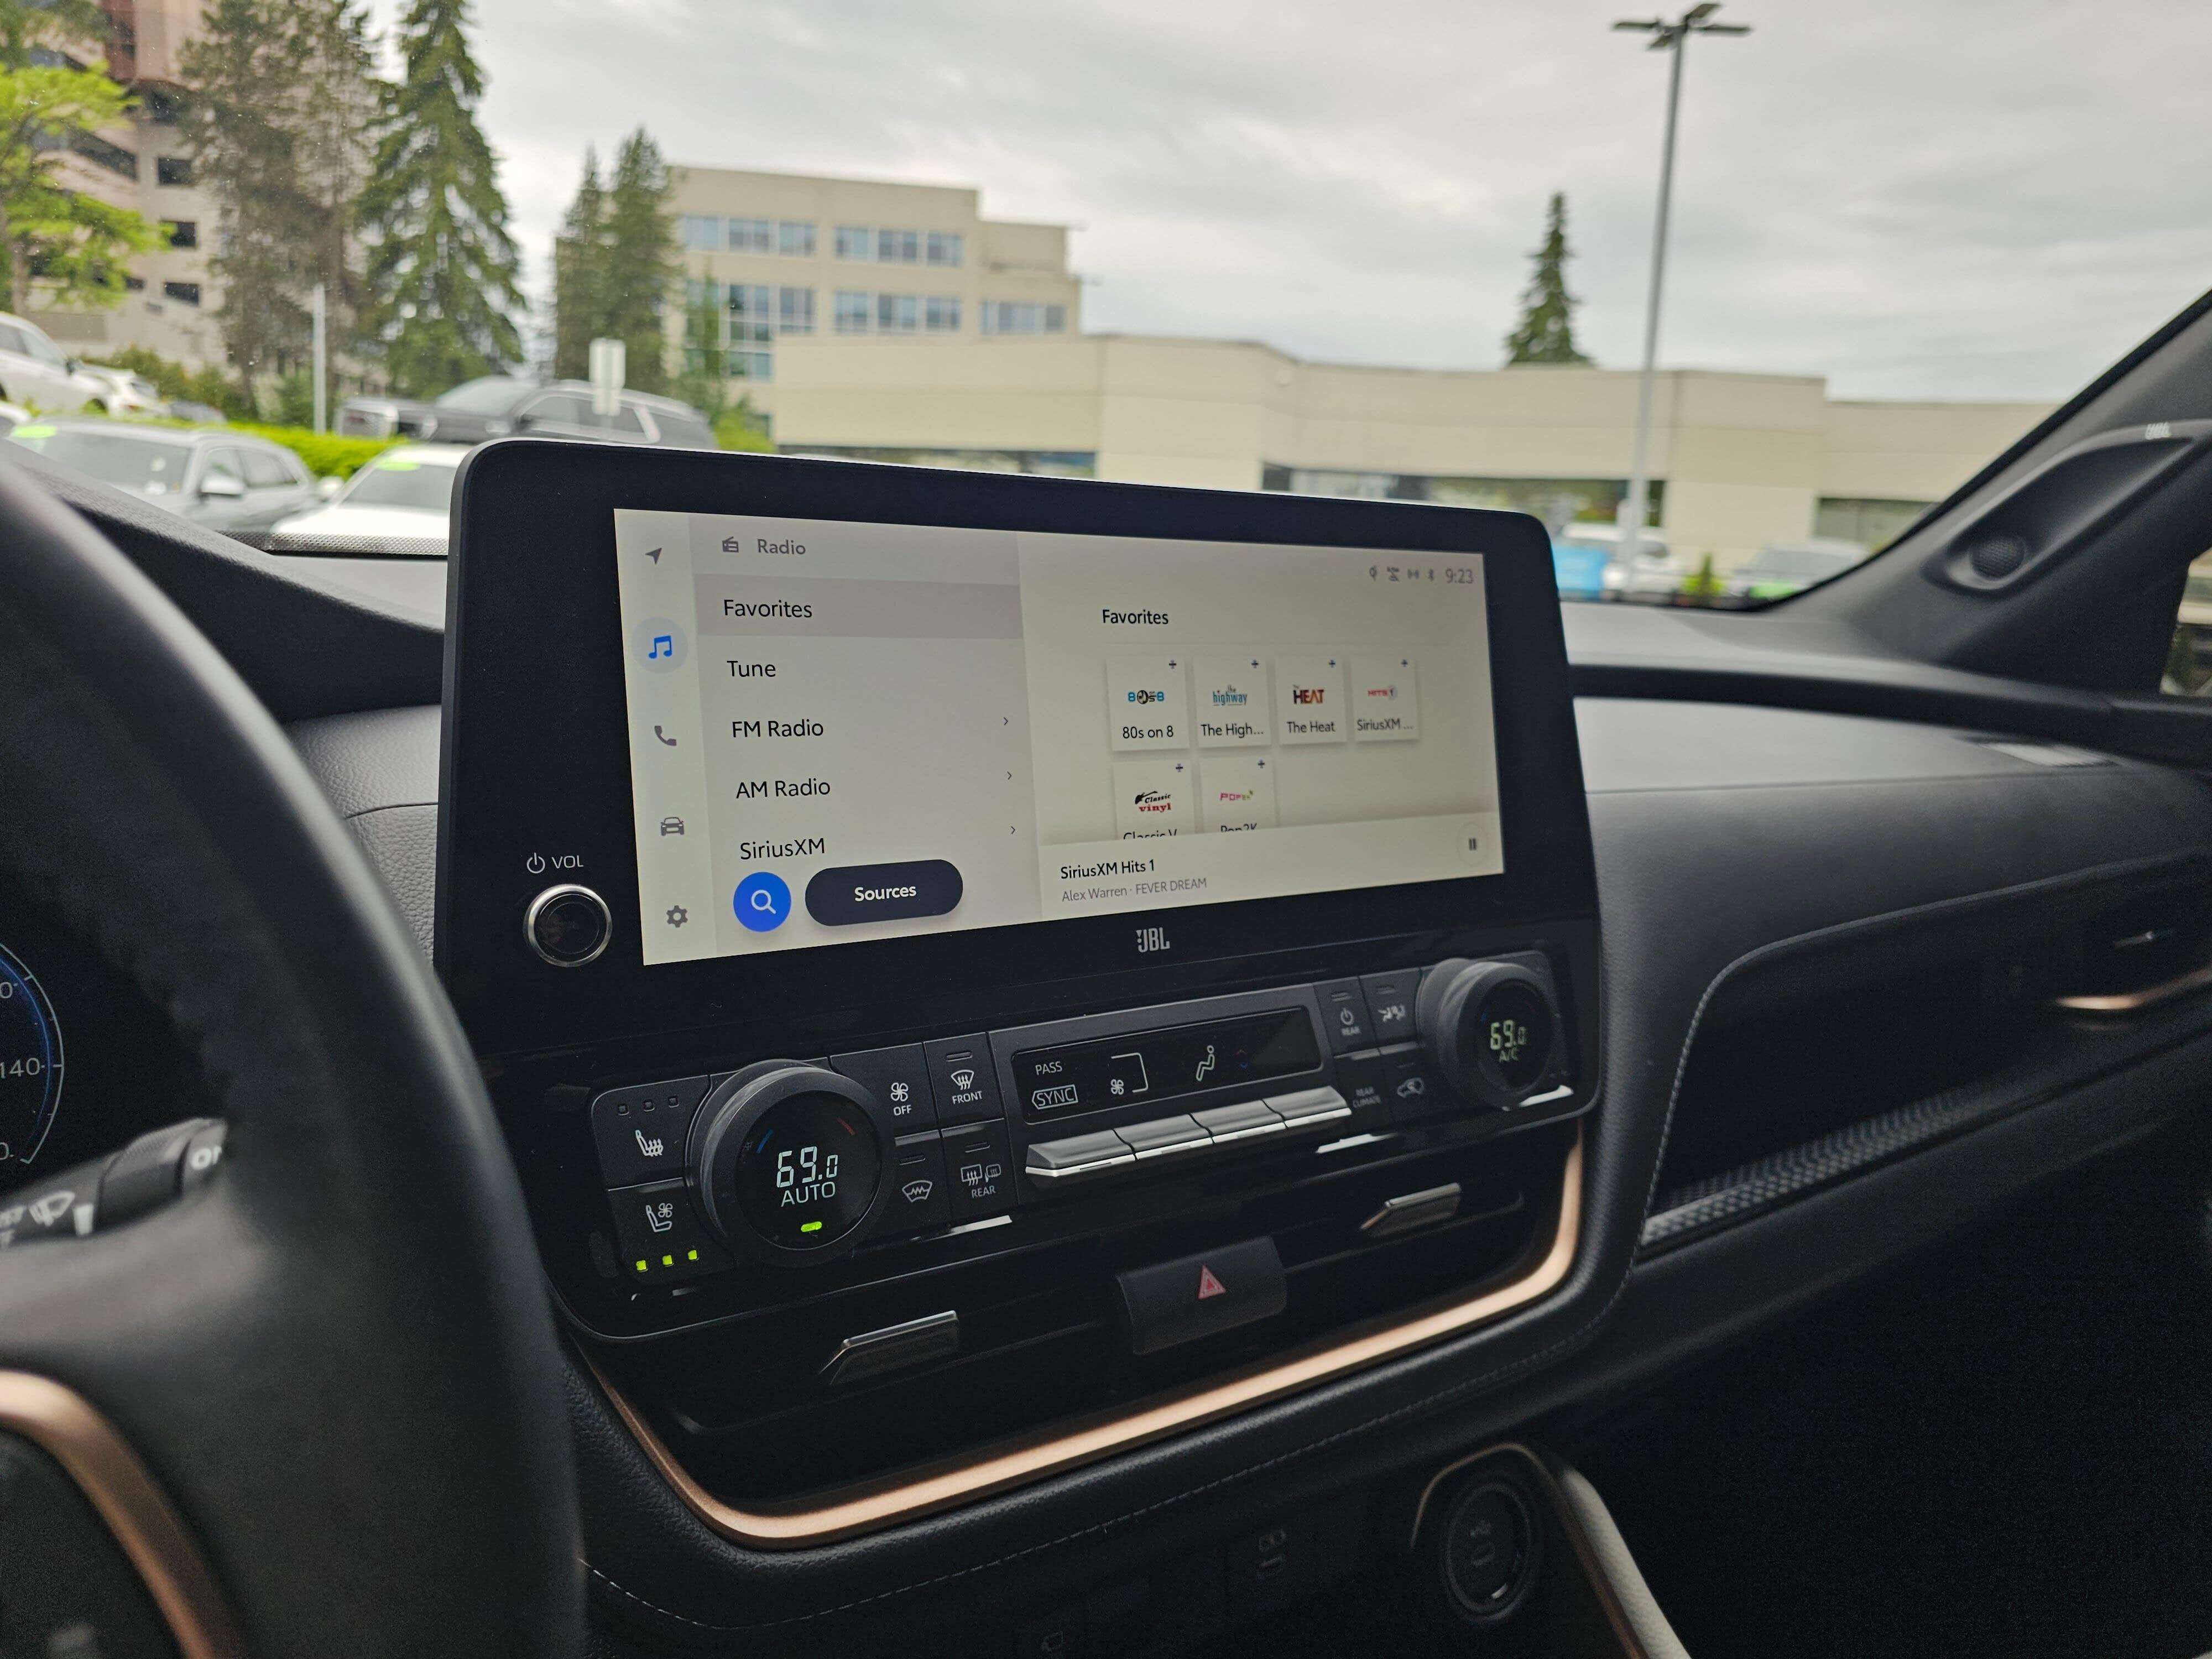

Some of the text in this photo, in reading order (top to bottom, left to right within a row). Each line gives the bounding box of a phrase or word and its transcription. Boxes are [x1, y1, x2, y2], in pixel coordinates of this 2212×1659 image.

[757, 539, 806, 555] Radio
[1446, 567, 1474, 584] 9:23
[723, 598, 813, 619] Favorites
[1102, 609, 1169, 625] Favorites
[727, 660, 776, 677] Tune
[1212, 691, 1248, 706] highway
[1293, 689, 1324, 704] HEAT
[732, 719, 824, 738] FM Radio
[1123, 725, 1174, 739] 80s on 8
[1201, 724, 1222, 737] The
[1287, 721, 1336, 734] The Heat
[1357, 718, 1401, 732] SiriusXM
[736, 778, 831, 799] AM Radio
[1139, 802, 1171, 813] vinyl
[739, 837, 826, 860] SiriusXM
[551, 855, 584, 869] VOL
[1061, 859, 1155, 879] SiriusXM Hits 1
[854, 884, 917, 902] Sources
[1062, 877, 1207, 902] Alex Warren FEVER DREAM
[1136, 927, 1170, 953] JBL
[1490, 1020, 1526, 1050] 69.0
[1035, 1061, 1062, 1075] PASS
[952, 1091, 983, 1104] FRONT
[1036, 1087, 1075, 1106] SYNC
[894, 1105, 912, 1116] OFF
[776, 1146, 838, 1188] 69.0
[781, 1181, 836, 1207] AUTO
[971, 1185, 996, 1198] REAR
